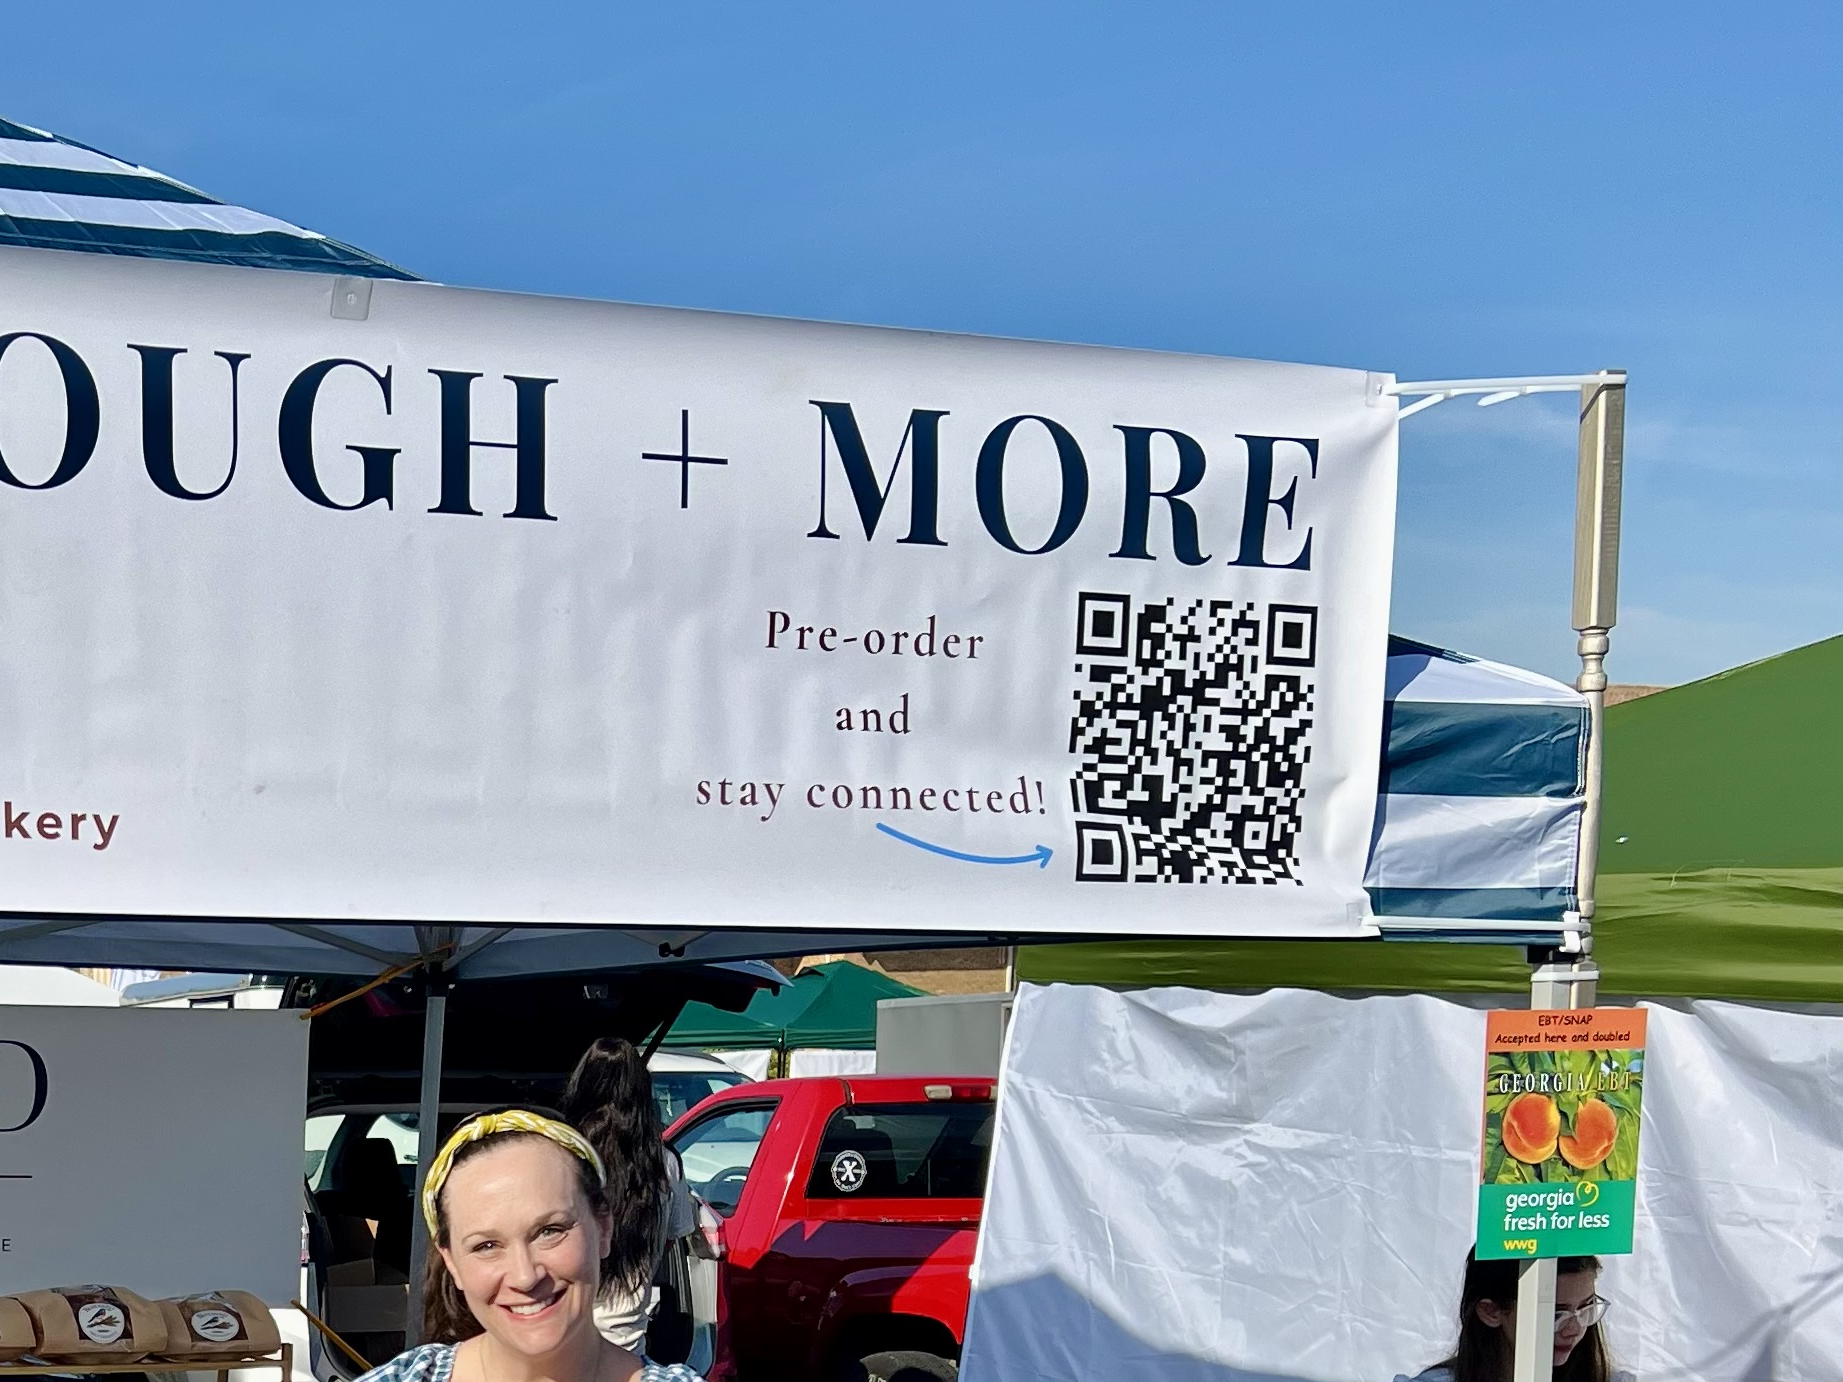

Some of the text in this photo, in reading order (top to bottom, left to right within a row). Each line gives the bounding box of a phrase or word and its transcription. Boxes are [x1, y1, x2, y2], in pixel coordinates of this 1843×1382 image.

[642, 409, 729, 509] +
[806, 399, 1321, 571] MORE
[765, 610, 985, 660] Pre-order
[835, 694, 911, 736] and
[696, 777, 1048, 823] stay connected!
[1538, 1015, 1593, 1027] EBT/SNAP
[1495, 1031, 1630, 1045] Accepted here and doubled
[1499, 1071, 1633, 1094] GEORGIA EBT
[1506, 1188, 1575, 1212] georgia
[1503, 1211, 1610, 1231] fresh for less
[1503, 1237, 1537, 1254] wwg
